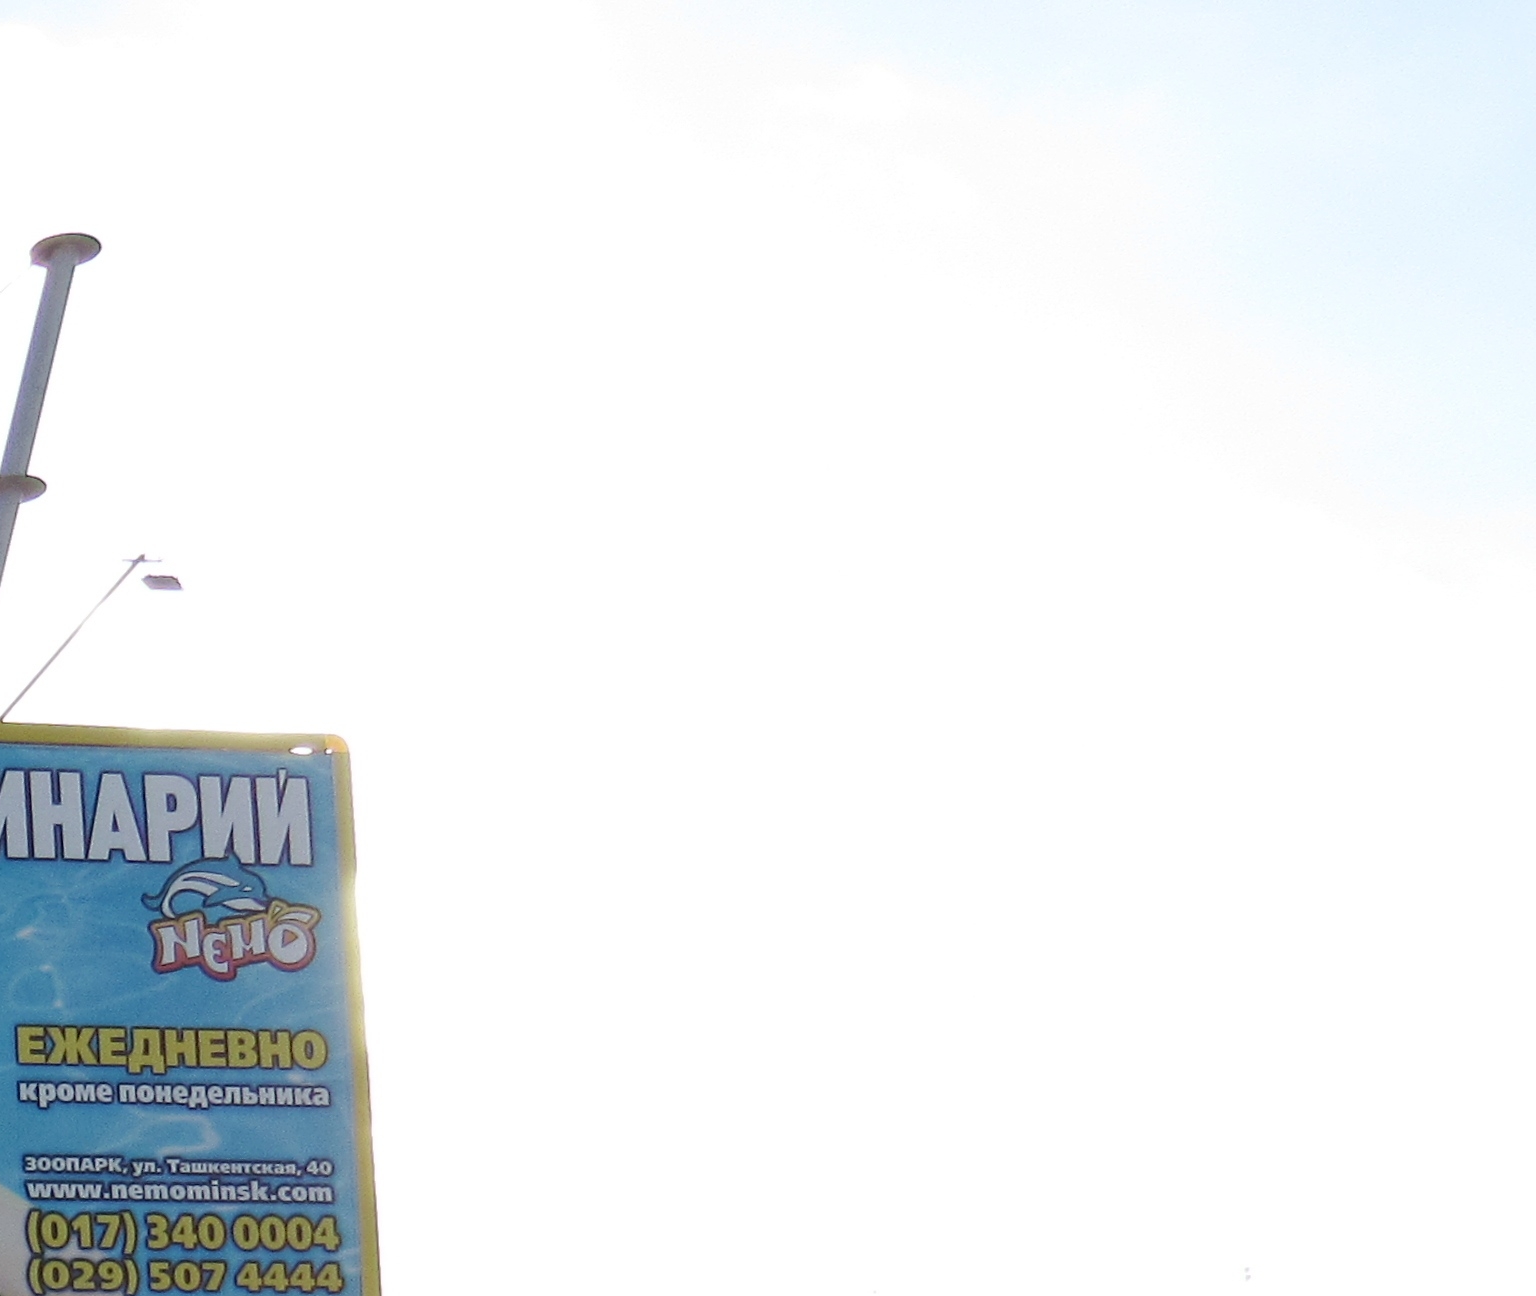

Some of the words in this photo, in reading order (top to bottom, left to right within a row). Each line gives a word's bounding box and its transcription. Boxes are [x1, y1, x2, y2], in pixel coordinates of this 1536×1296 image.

[16, 1025, 328, 1074] ЕЖЕДНЕВНО
[19, 1080, 113, 1108] кроме
[118, 1082, 330, 1109] понедельника
[24, 1156, 128, 1175] ЗООПАРК,
[131, 1159, 162, 1177] ул.
[166, 1158, 303, 1176] Ташкентская,
[306, 1160, 334, 1176] 40
[26, 1179, 334, 1202] www.nemominsk.com
[27, 1210, 137, 1255] (017)
[145, 1213, 226, 1250] 340
[232, 1215, 341, 1251] 0004
[28, 1257, 138, 1296] (029)
[148, 1261, 226, 1291] 507
[236, 1262, 343, 1293] 4444
